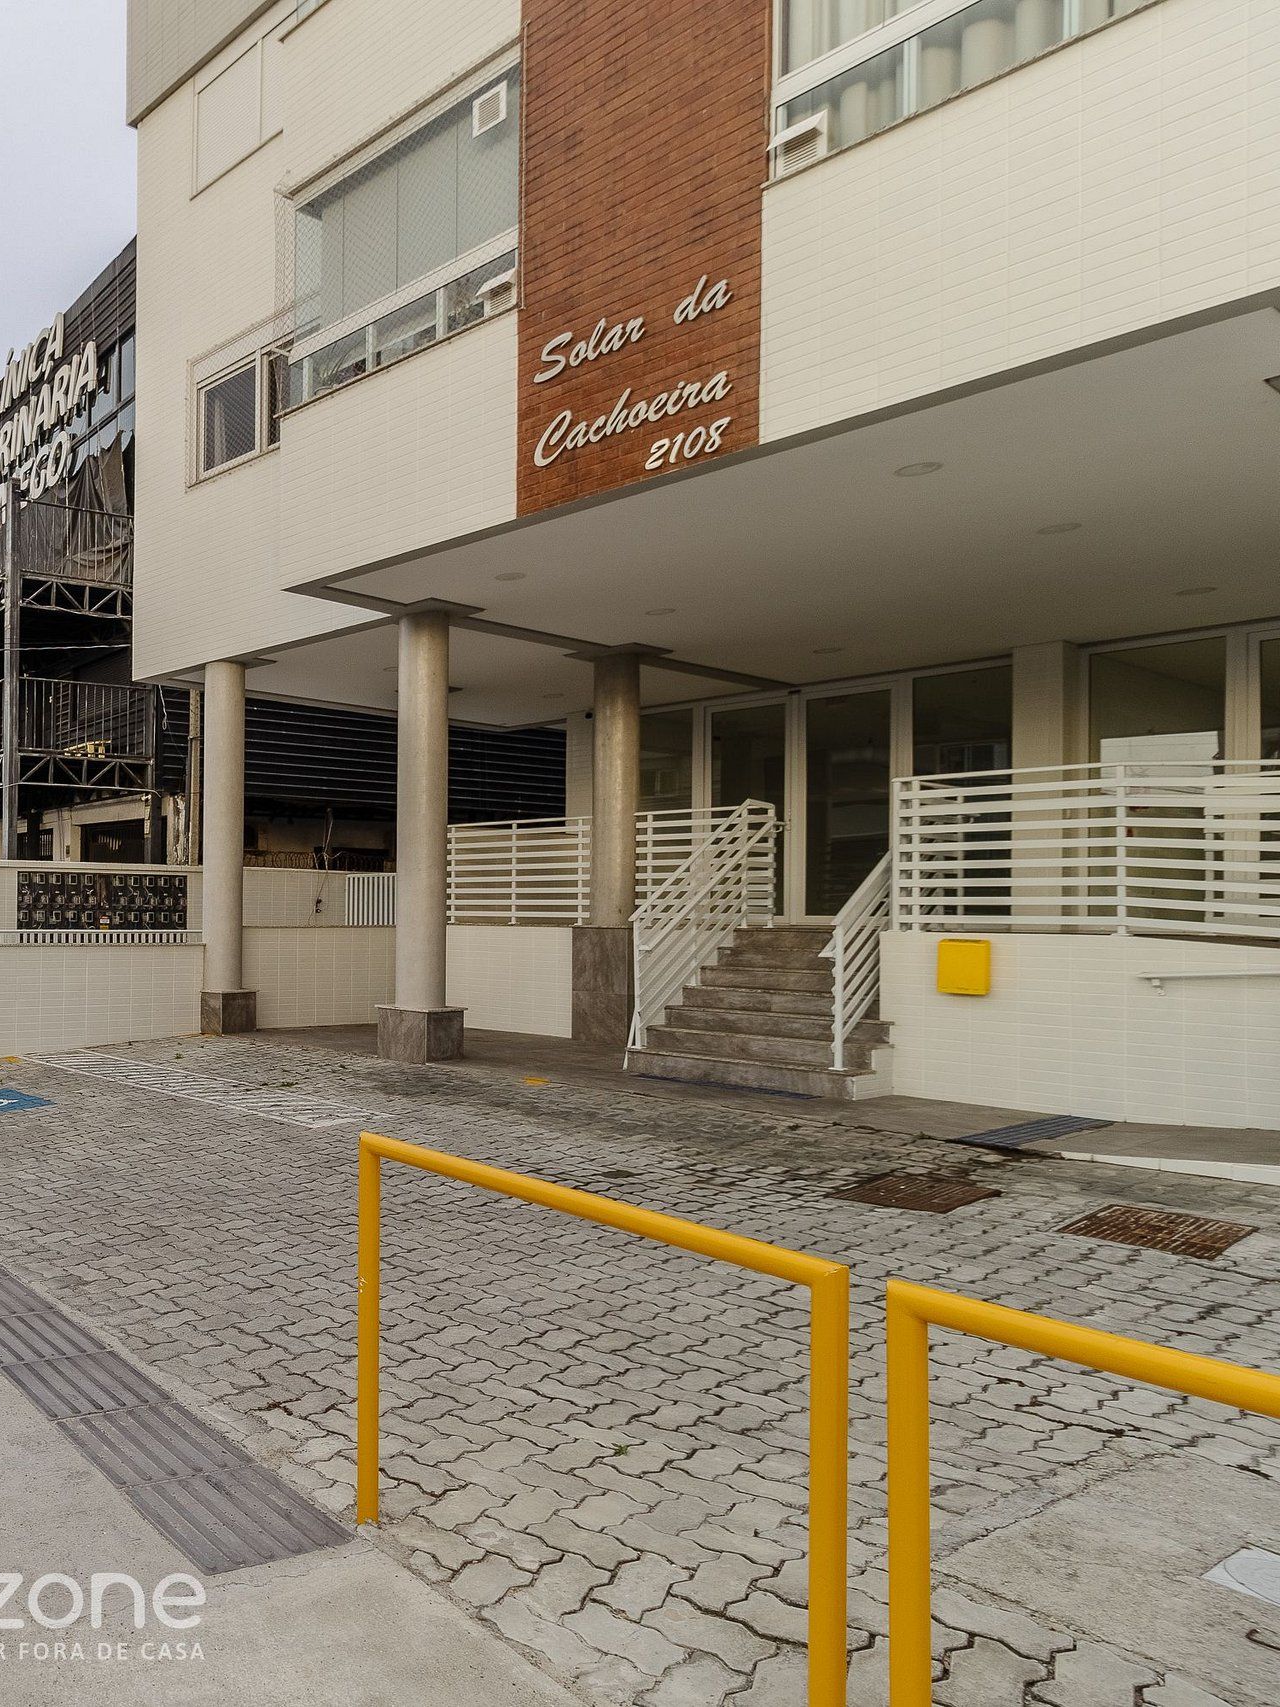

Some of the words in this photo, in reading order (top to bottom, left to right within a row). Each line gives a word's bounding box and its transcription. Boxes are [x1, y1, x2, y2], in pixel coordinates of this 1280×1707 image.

[533, 317, 645, 384] Solar
[673, 274, 734, 325] da
[533, 370, 733, 468] Cachoeira
[644, 416, 732, 471] 2108
